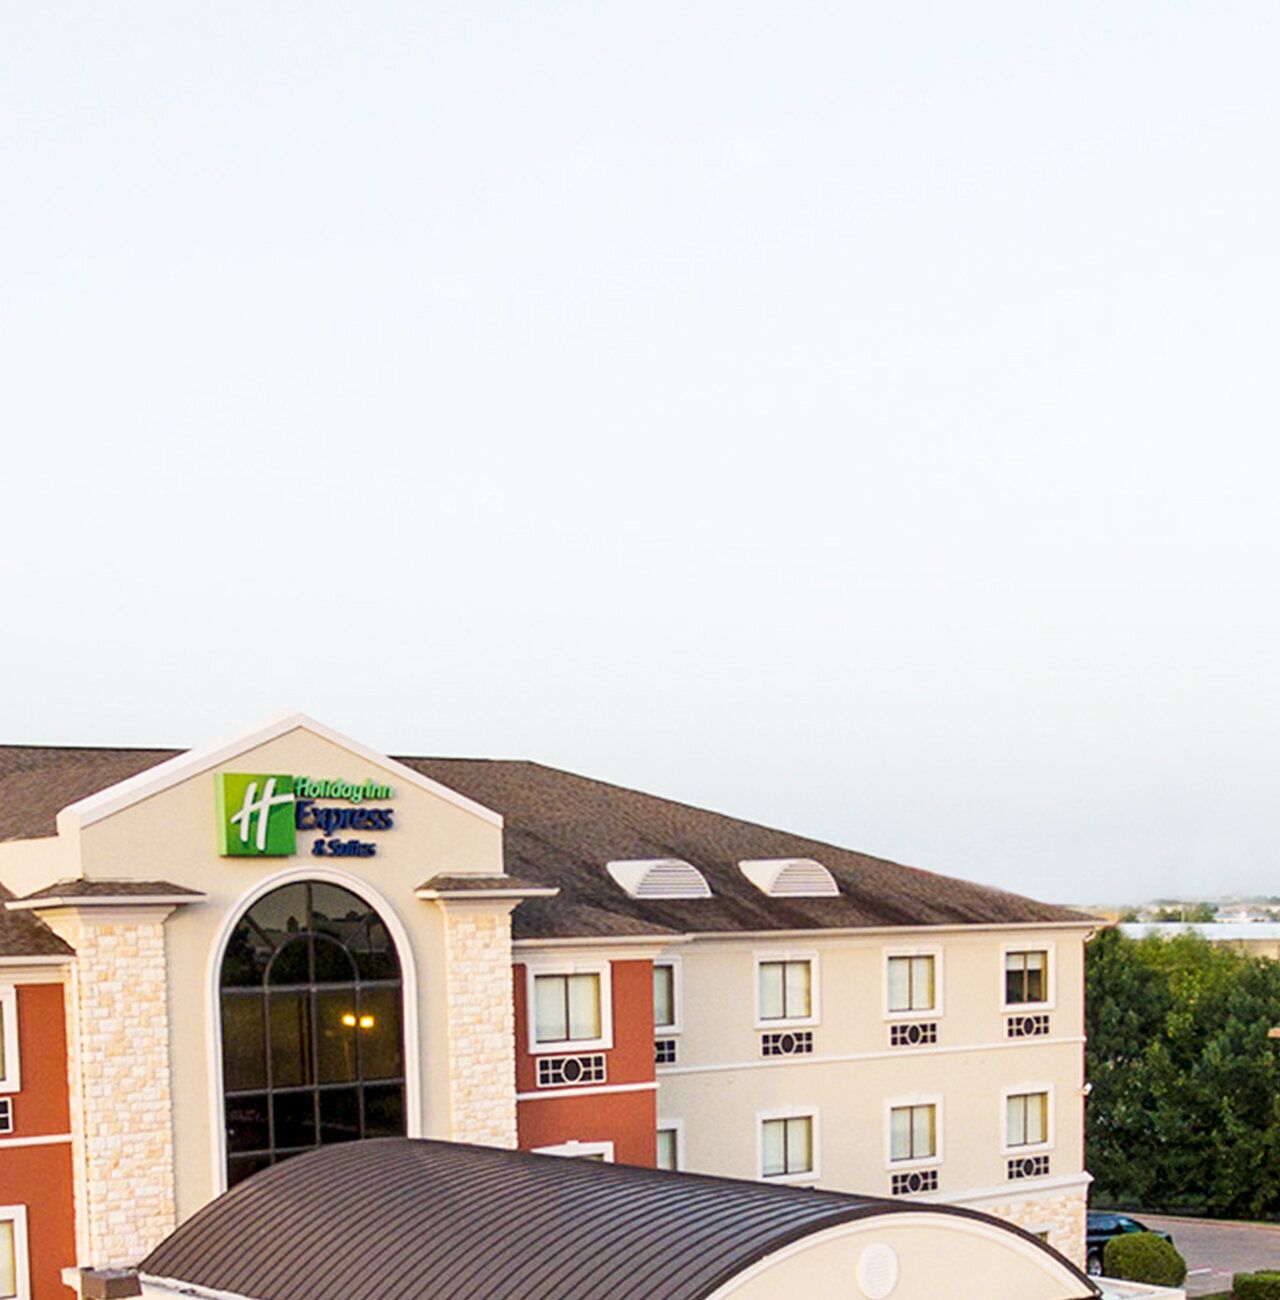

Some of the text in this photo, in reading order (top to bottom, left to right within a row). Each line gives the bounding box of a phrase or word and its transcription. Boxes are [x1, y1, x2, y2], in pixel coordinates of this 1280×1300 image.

[295, 777, 394, 804] Holiday Inn
[295, 800, 394, 837] Express
[311, 839, 376, 857] & Suites
